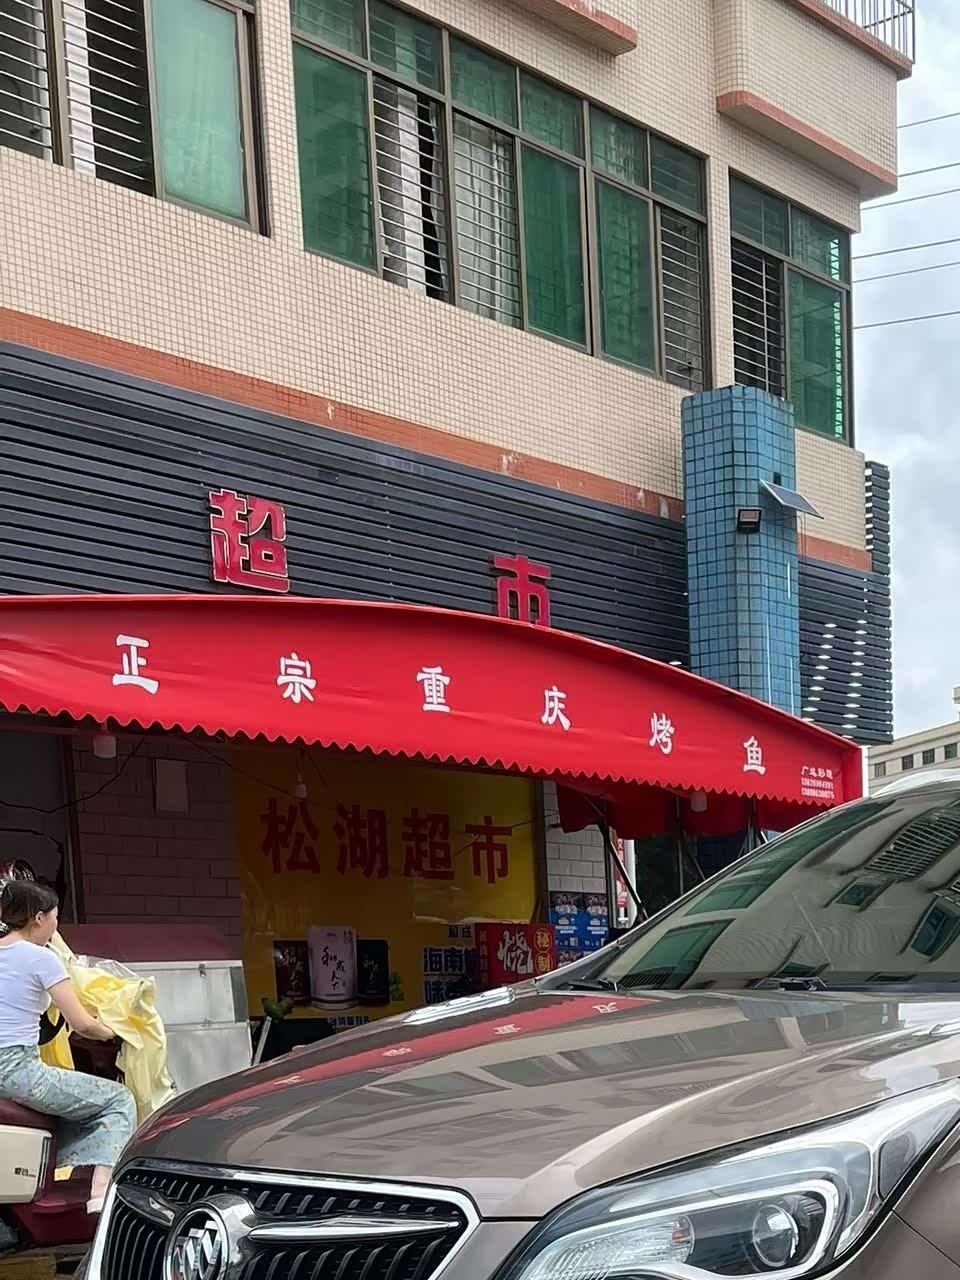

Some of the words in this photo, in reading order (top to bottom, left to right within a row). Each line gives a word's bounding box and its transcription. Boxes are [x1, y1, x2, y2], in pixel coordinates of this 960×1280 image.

[112, 634, 766, 775] 正宗重庆烤鱼
[261, 798, 512, 884] 松湖超市
